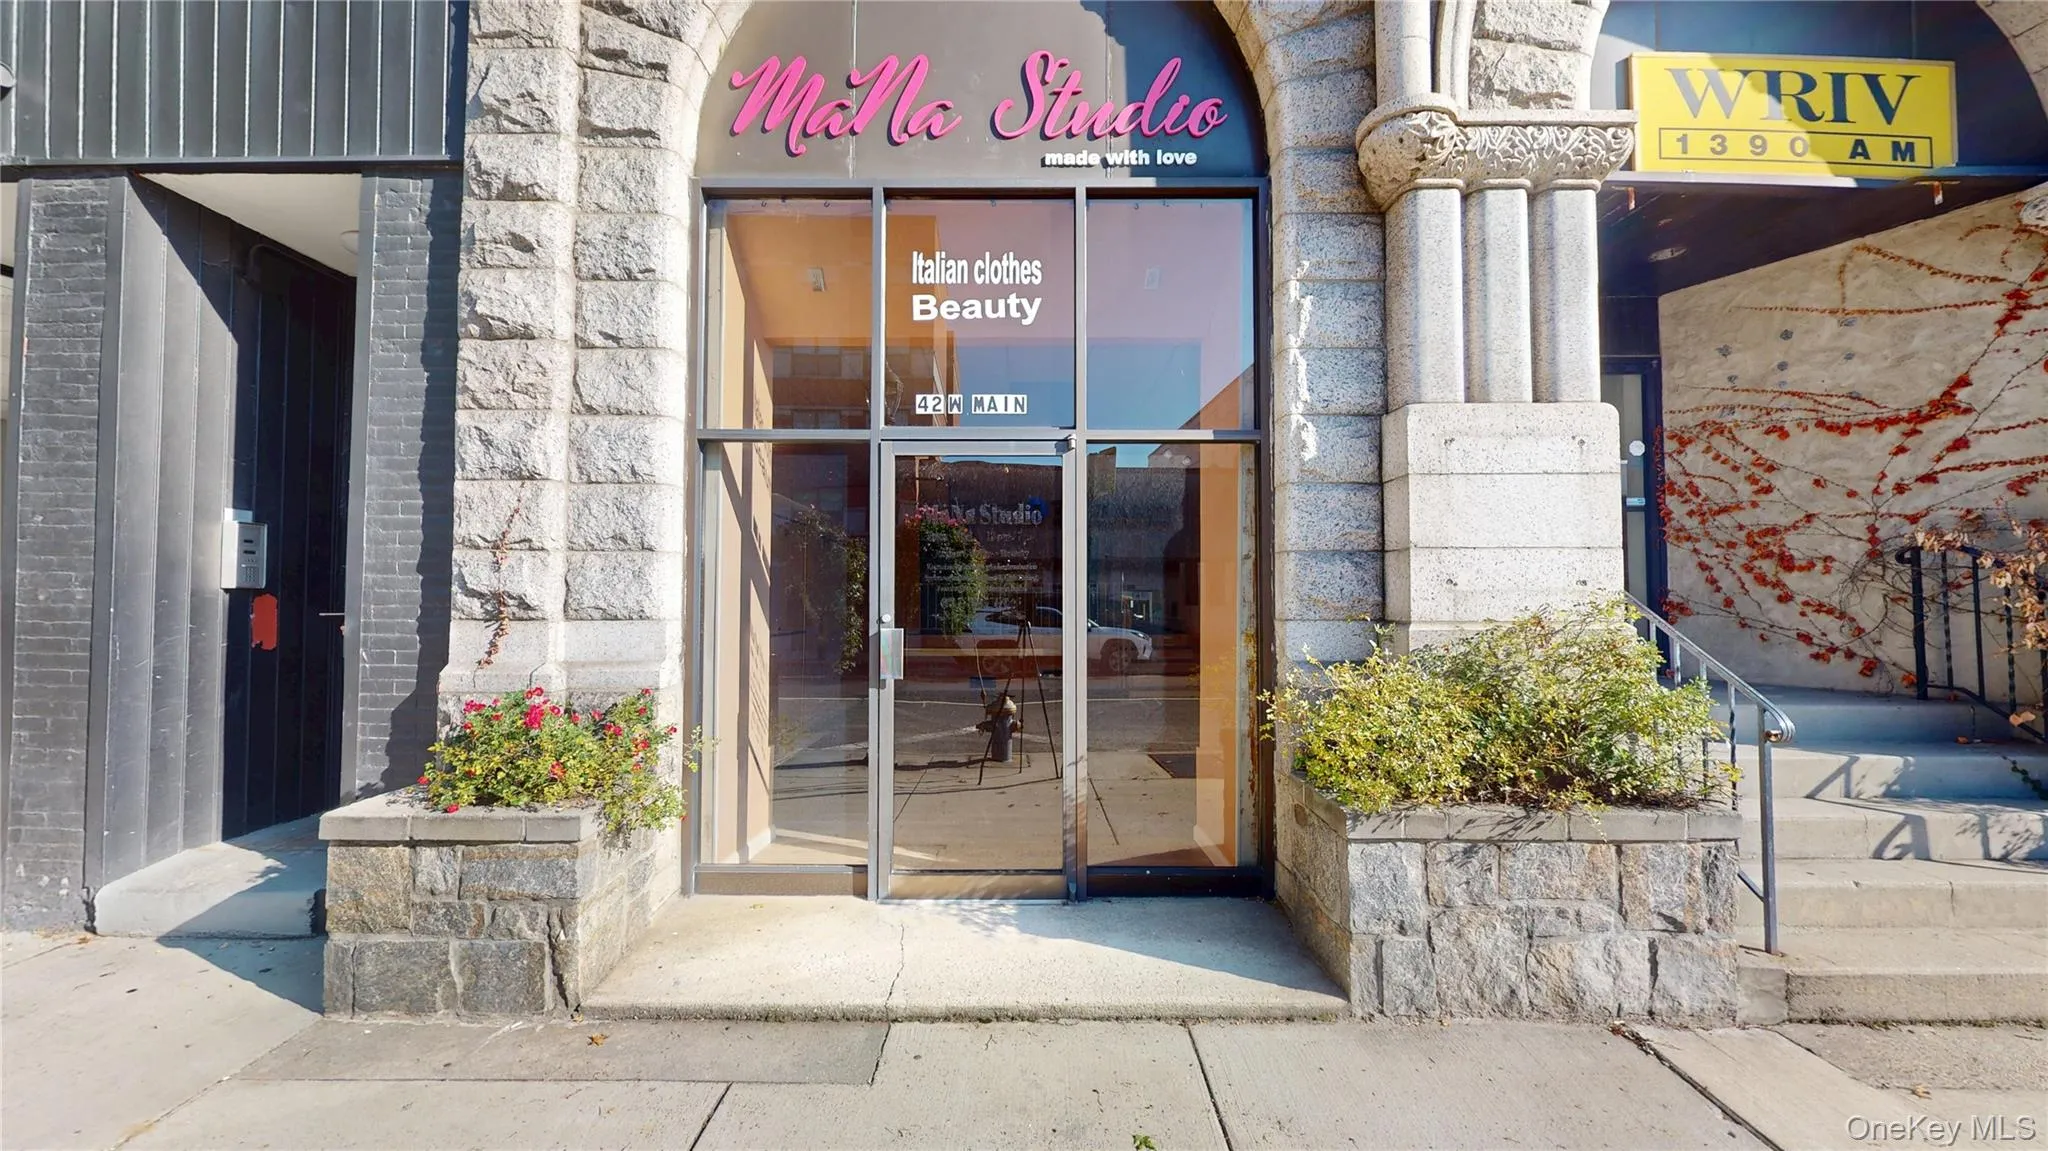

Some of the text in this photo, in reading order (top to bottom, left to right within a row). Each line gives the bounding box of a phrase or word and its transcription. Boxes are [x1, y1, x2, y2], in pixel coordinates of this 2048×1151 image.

[730, 50, 1228, 156] MaNa Studio
[1664, 68, 1921, 125] WRIV
[1043, 149, 1198, 166] made with love
[1676, 133, 1916, 163] 1390 AM
[912, 251, 1042, 285] Italian clothes
[912, 292, 1042, 325] Beauty
[973, 396, 1026, 413] MAIN
[979, 501, 1043, 525] Studio
